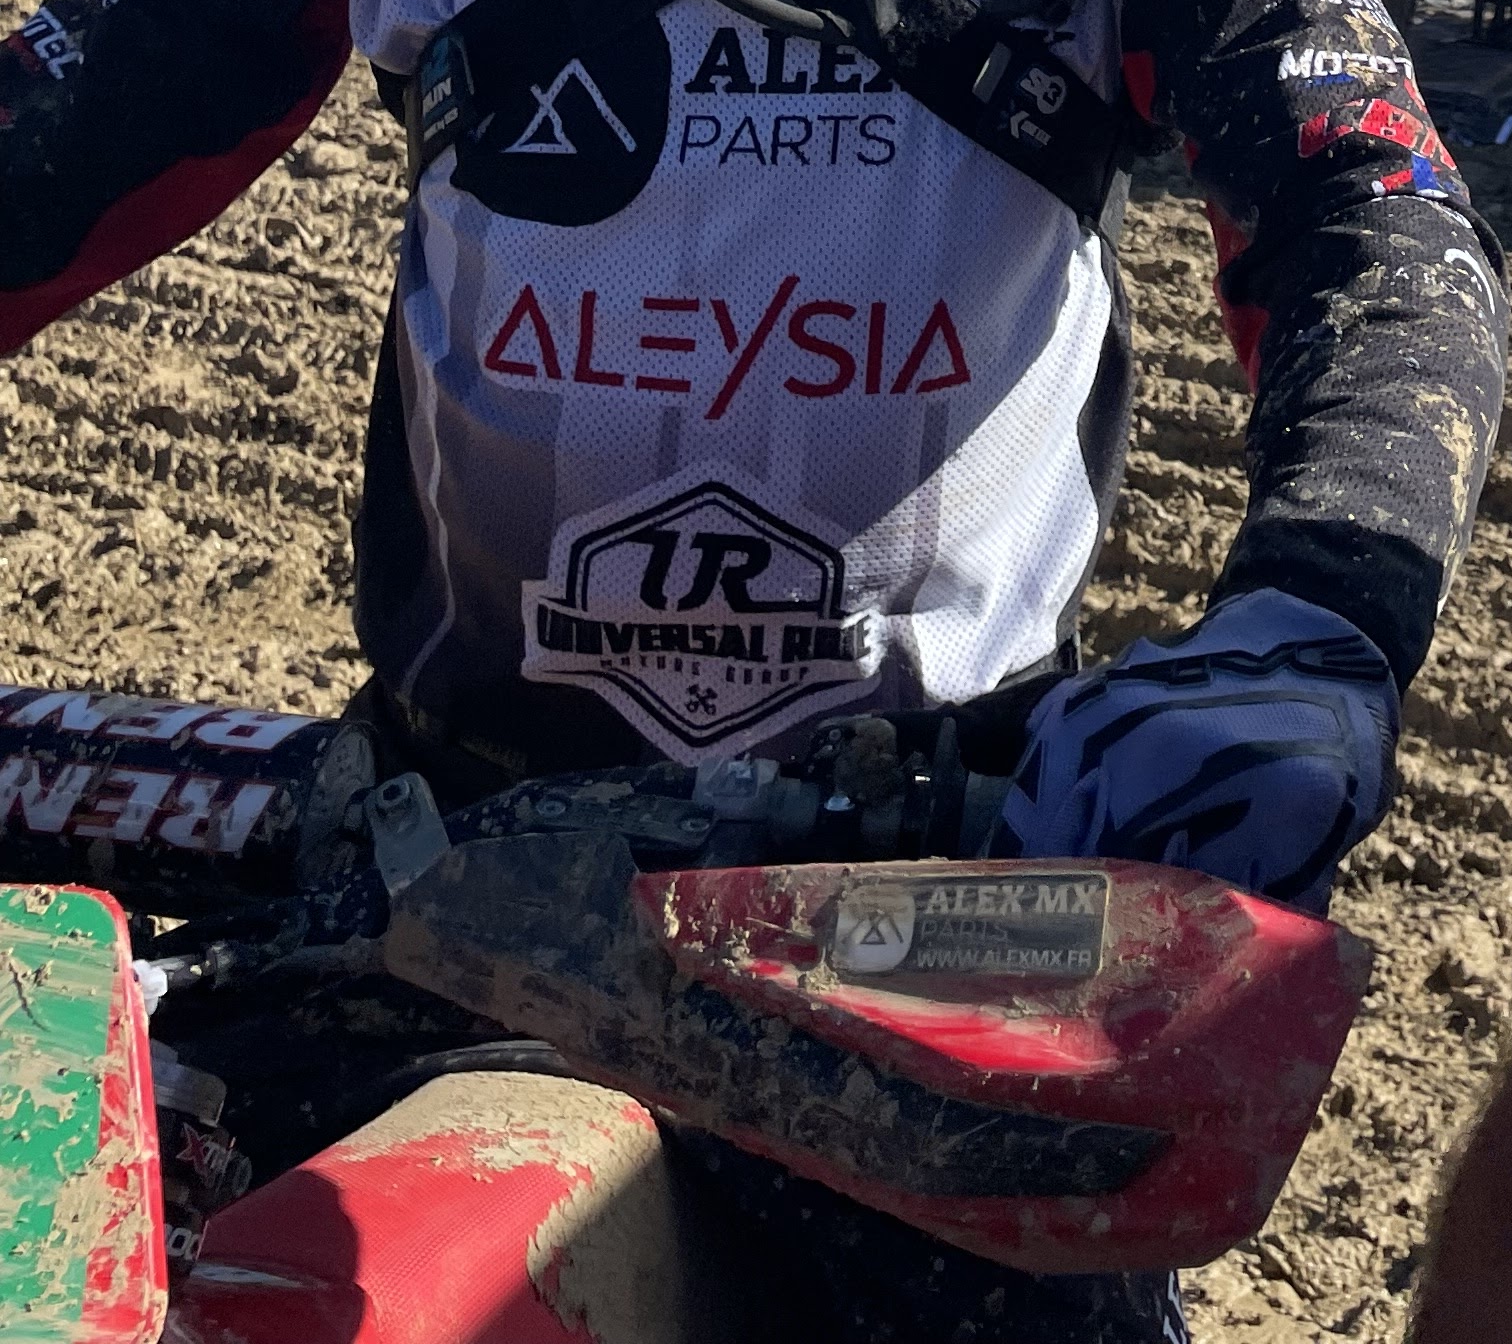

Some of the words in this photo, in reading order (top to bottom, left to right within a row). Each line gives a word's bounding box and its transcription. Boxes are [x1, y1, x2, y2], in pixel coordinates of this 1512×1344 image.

[683, 26, 895, 95] ALE
[679, 113, 897, 167] PARTS
[483, 273, 972, 421] ALEYSIA
[536, 601, 769, 663] UNIVERSAL
[0, 684, 320, 752] REN
[923, 884, 1026, 915] ALEX
[1034, 883, 1100, 916] MX
